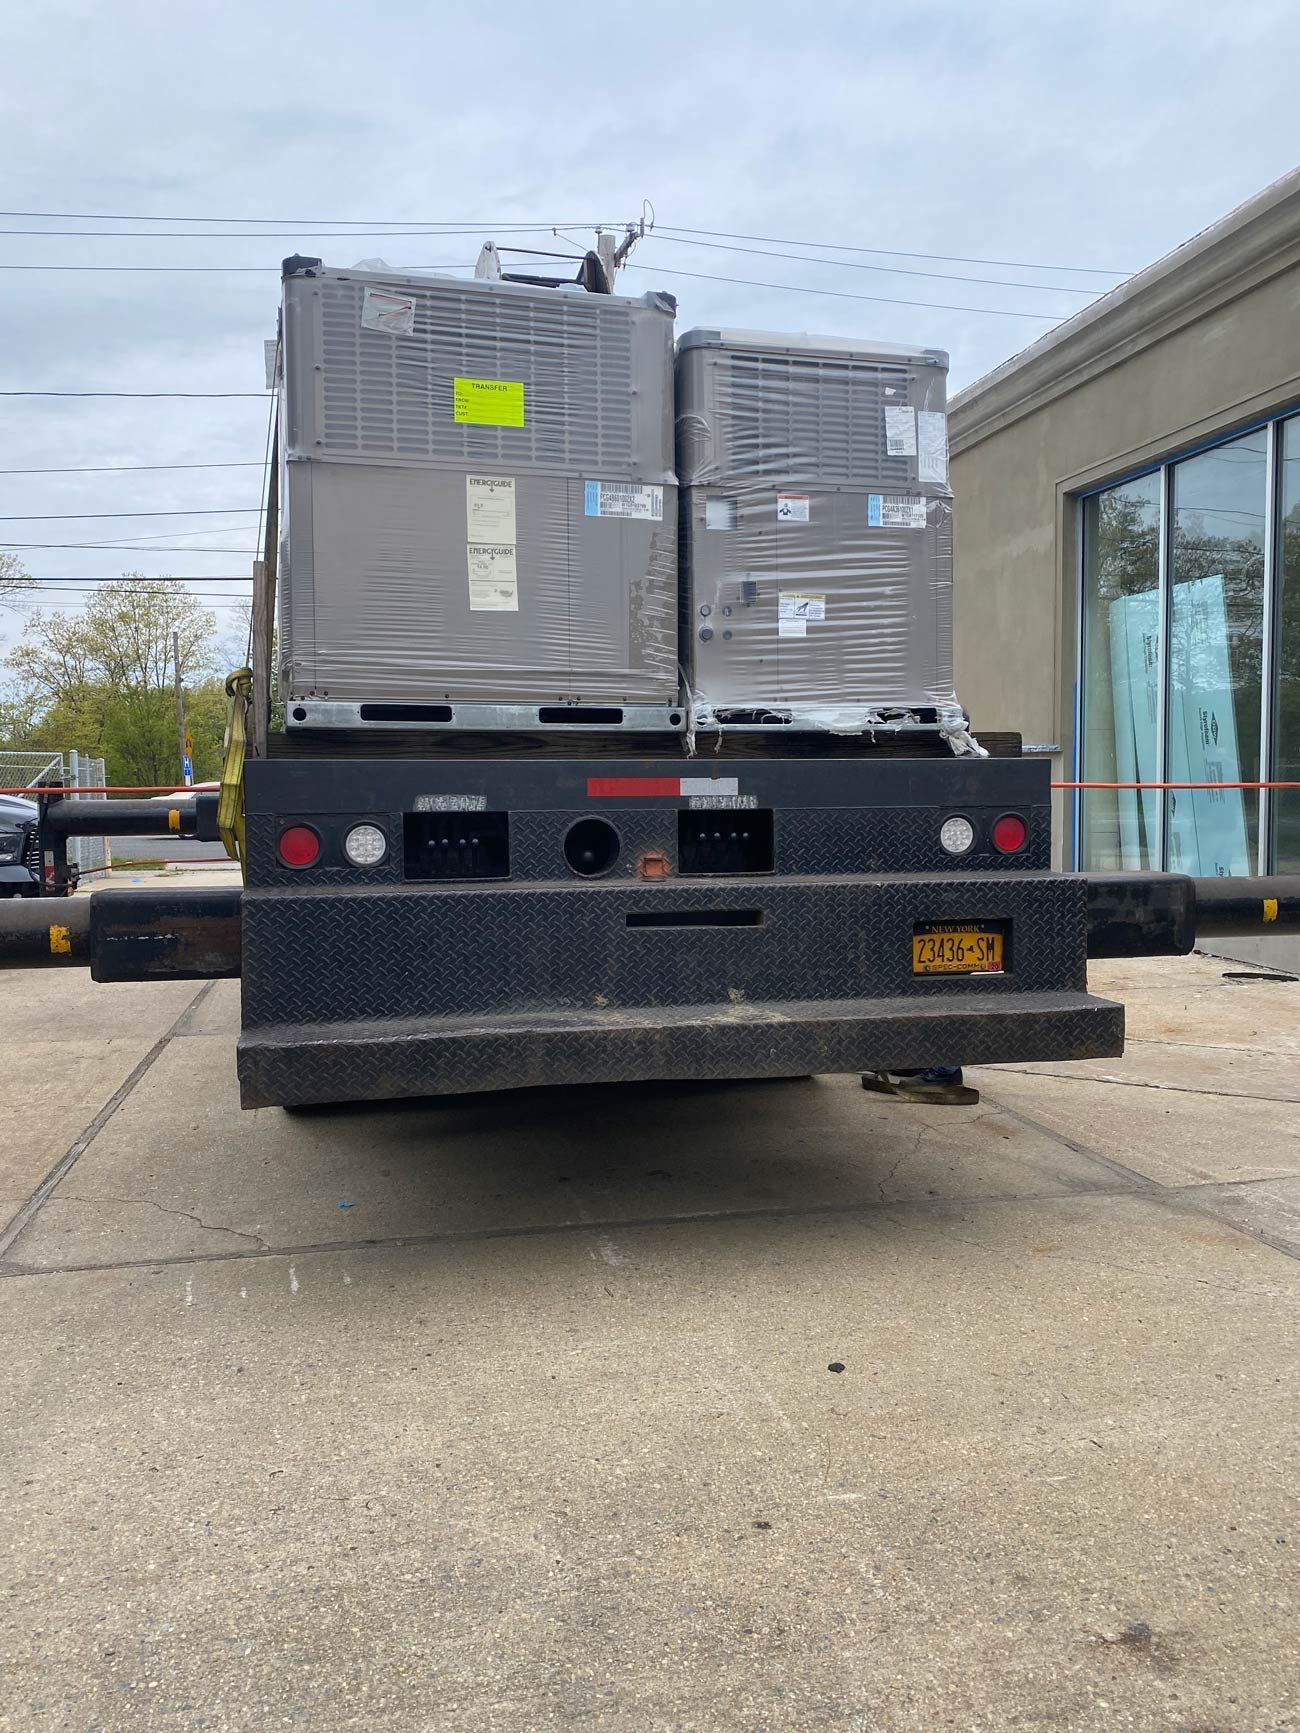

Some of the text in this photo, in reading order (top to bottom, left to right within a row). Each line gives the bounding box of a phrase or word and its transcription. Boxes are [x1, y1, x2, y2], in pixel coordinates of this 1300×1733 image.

[472, 383, 508, 391] TRANSFER
[1202, 710, 1210, 745] Styrofoam
[931, 924, 980, 933] NEW YORK
[917, 937, 995, 963] 23436 SM
